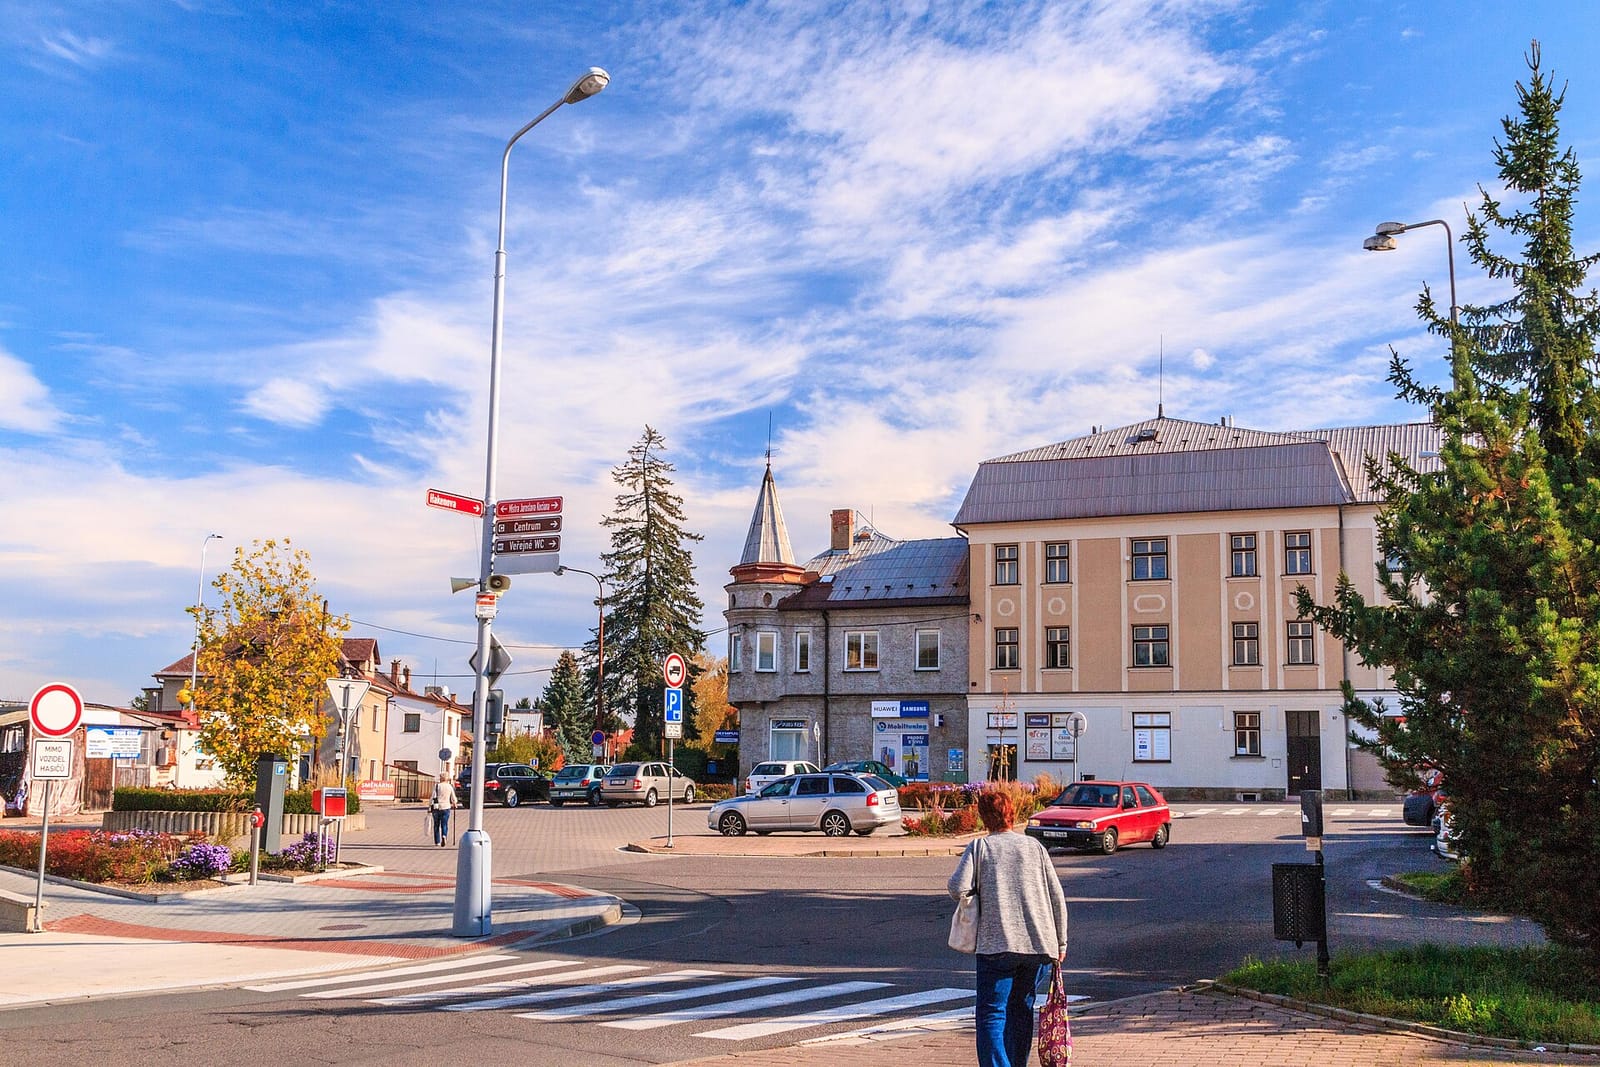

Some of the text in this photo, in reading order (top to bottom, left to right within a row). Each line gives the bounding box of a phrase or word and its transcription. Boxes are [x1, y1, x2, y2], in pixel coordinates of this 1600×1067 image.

[513, 522, 541, 532] Centrum
[509, 539, 545, 552] Veřejné WC
[887, 723, 928, 731] Mobiltuning
